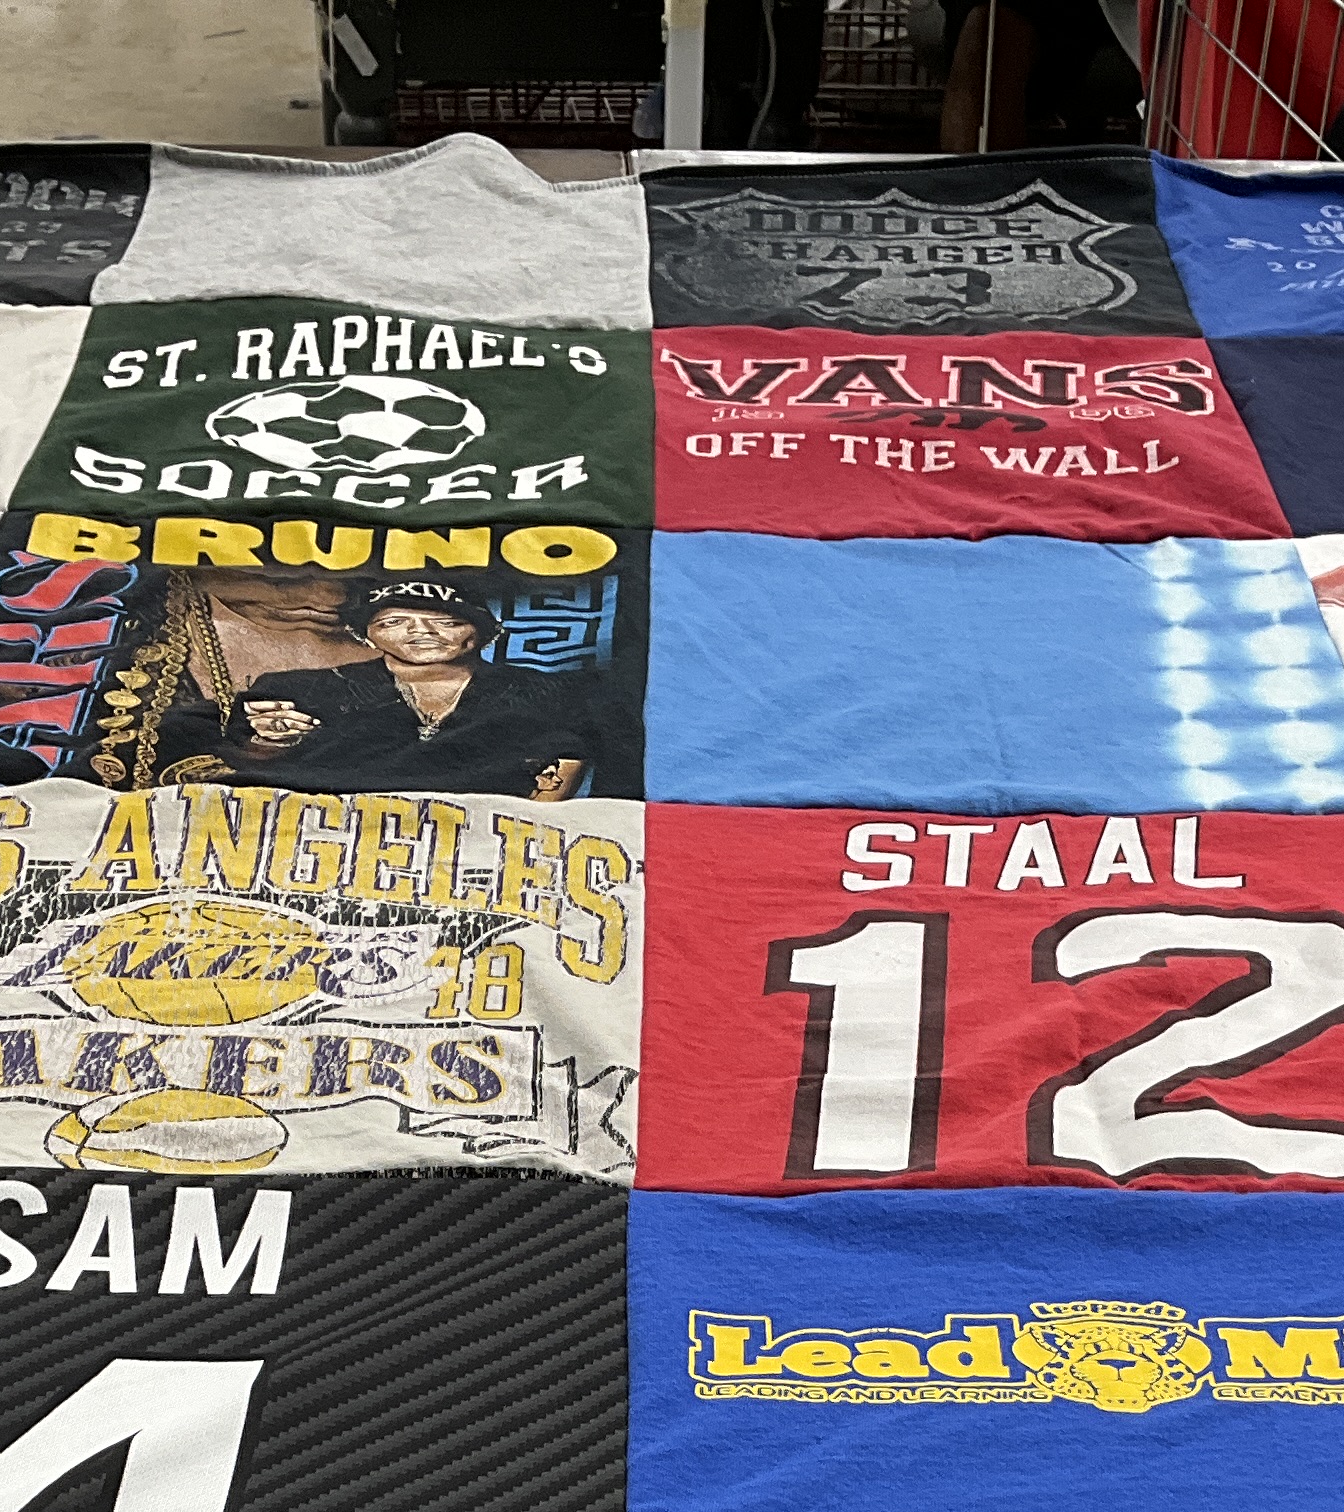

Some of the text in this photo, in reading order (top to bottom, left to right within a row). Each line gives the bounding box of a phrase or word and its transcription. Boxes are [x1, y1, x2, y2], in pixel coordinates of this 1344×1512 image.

[745, 206, 1046, 240] DODGE
[103, 314, 608, 389] ST. RAPHAEL'S
[660, 348, 1216, 416] VANS
[69, 446, 589, 509] SOCCER
[685, 431, 1180, 478] OFF THE WALL
[25, 512, 619, 576] BRUNO
[67, 783, 636, 985] ANGELES
[840, 814, 1248, 892] STAAL
[1033, 1301, 1185, 1320] Leopards
[701, 1318, 1013, 1380] Lead
[698, 1384, 1050, 1401] LEADING AND LEARNING
